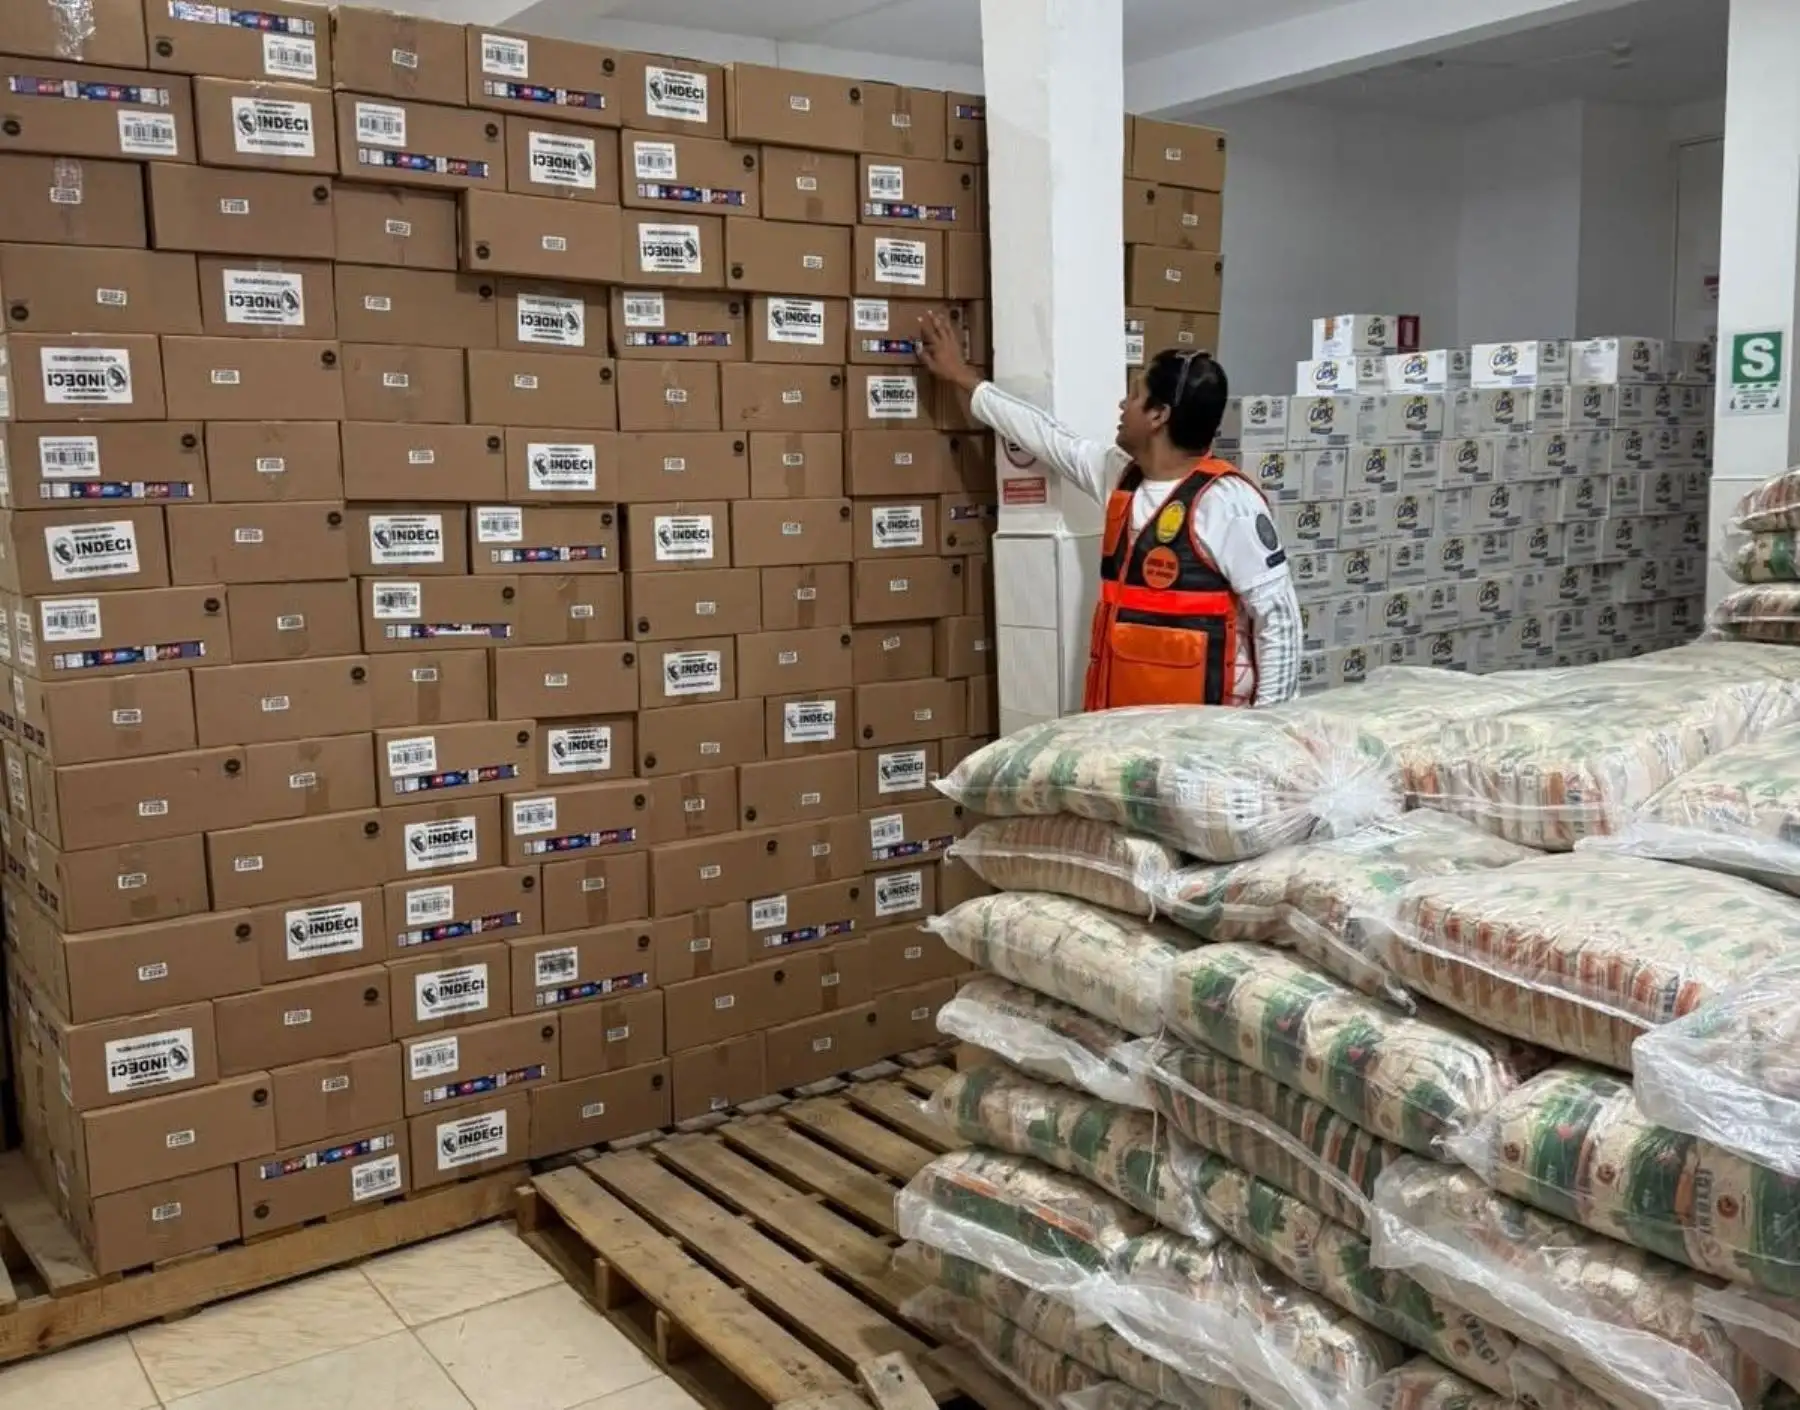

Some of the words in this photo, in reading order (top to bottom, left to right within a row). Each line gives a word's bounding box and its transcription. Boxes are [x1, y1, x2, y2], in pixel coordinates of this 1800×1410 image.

[664, 83, 705, 101] INDECI
[257, 114, 309, 132] INDECI
[533, 152, 577, 170] INDECI
[642, 244, 684, 259] INDECI
[889, 252, 924, 266] INDECI
[229, 295, 282, 309] INDECI
[520, 313, 563, 329] INDECI
[784, 310, 821, 325] INDECI
[1740, 337, 1775, 378] S
[47, 372, 106, 388] INDECI
[882, 388, 915, 400] INDECI
[549, 458, 593, 471] INDECI
[887, 517, 920, 530] INDECI
[391, 527, 440, 541] INDECI
[672, 527, 710, 540] INDECI
[76, 539, 132, 556] INDECI
[680, 662, 718, 675] INDECI
[799, 712, 834, 724] INDECI
[567, 737, 608, 751] INDECI
[890, 762, 924, 775] INDECI
[428, 828, 474, 845] INDECI
[309, 917, 359, 935] INDECI
[439, 978, 485, 996] INDECI
[111, 1056, 168, 1078] INDECI
[458, 1125, 503, 1144] INDECI
